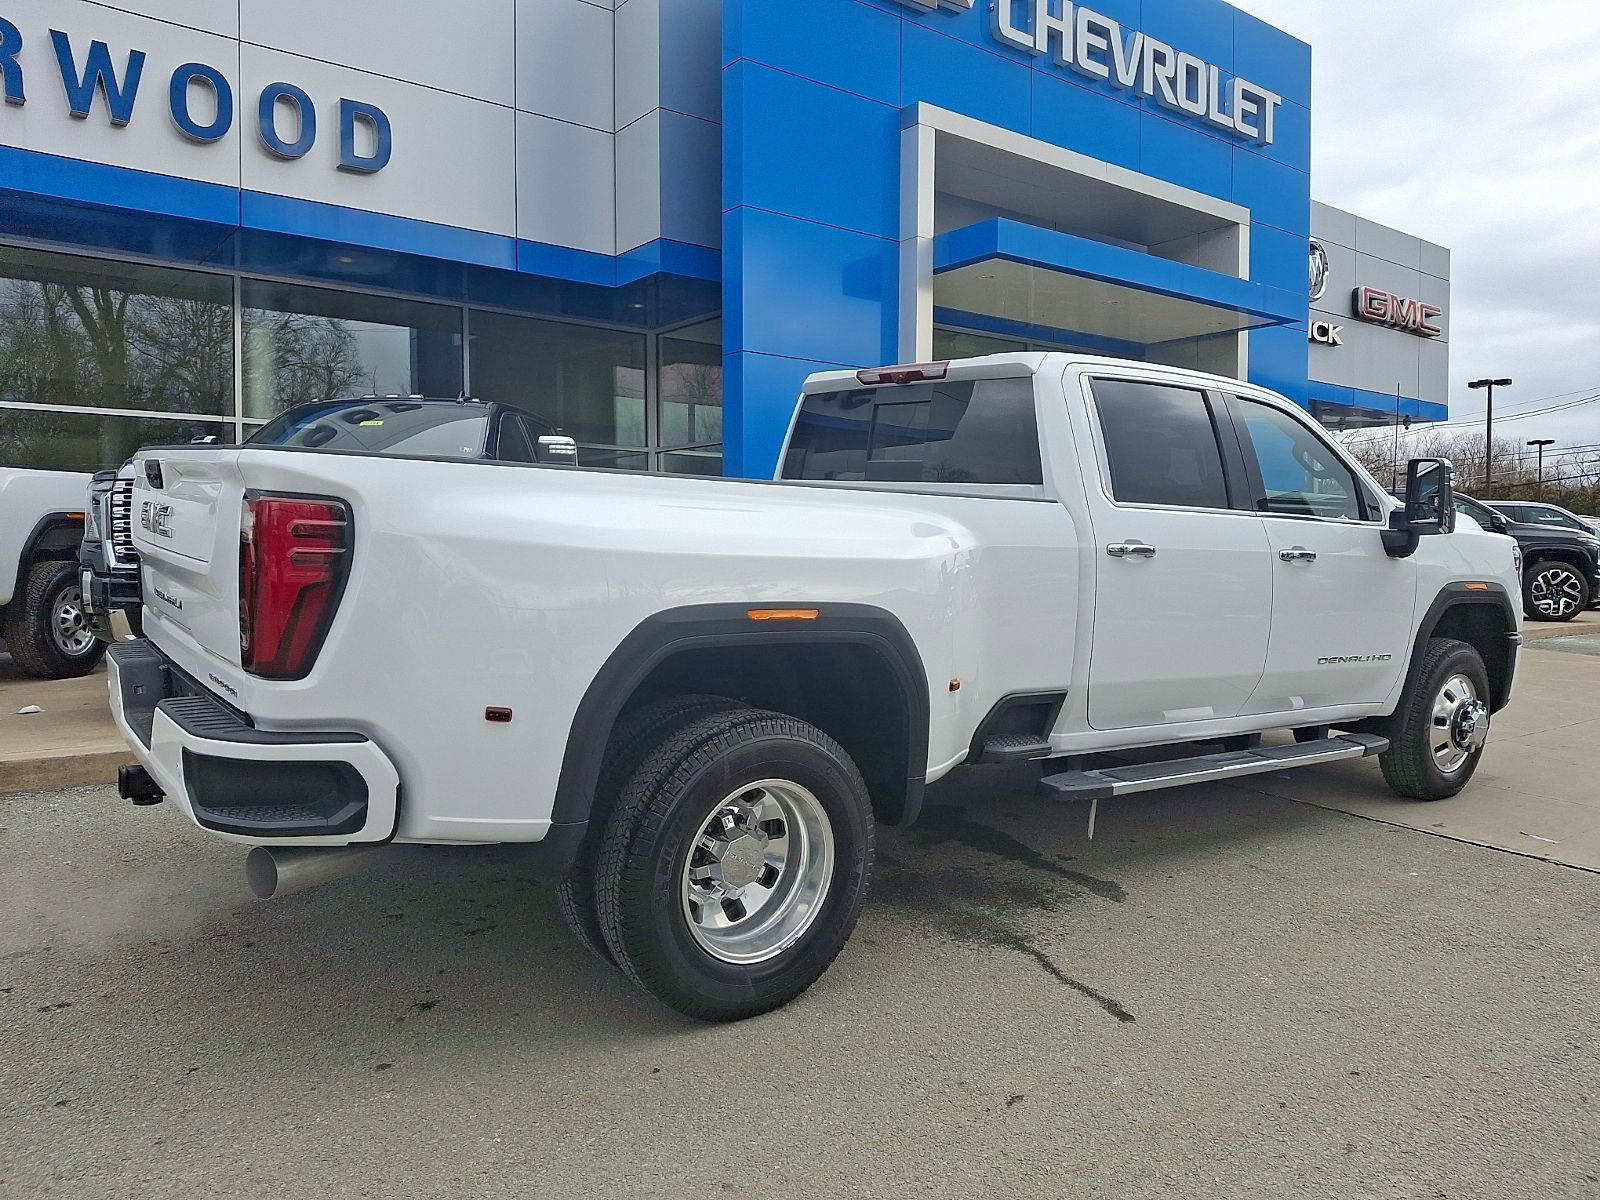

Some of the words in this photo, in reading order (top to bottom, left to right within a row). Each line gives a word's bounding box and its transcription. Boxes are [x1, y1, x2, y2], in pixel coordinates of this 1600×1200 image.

[993, 0, 1281, 146] CHEVROLET
[1355, 286, 1441, 336] GMC
[1317, 655, 1370, 665] DENALI
[1371, 653, 1391, 662] HD
